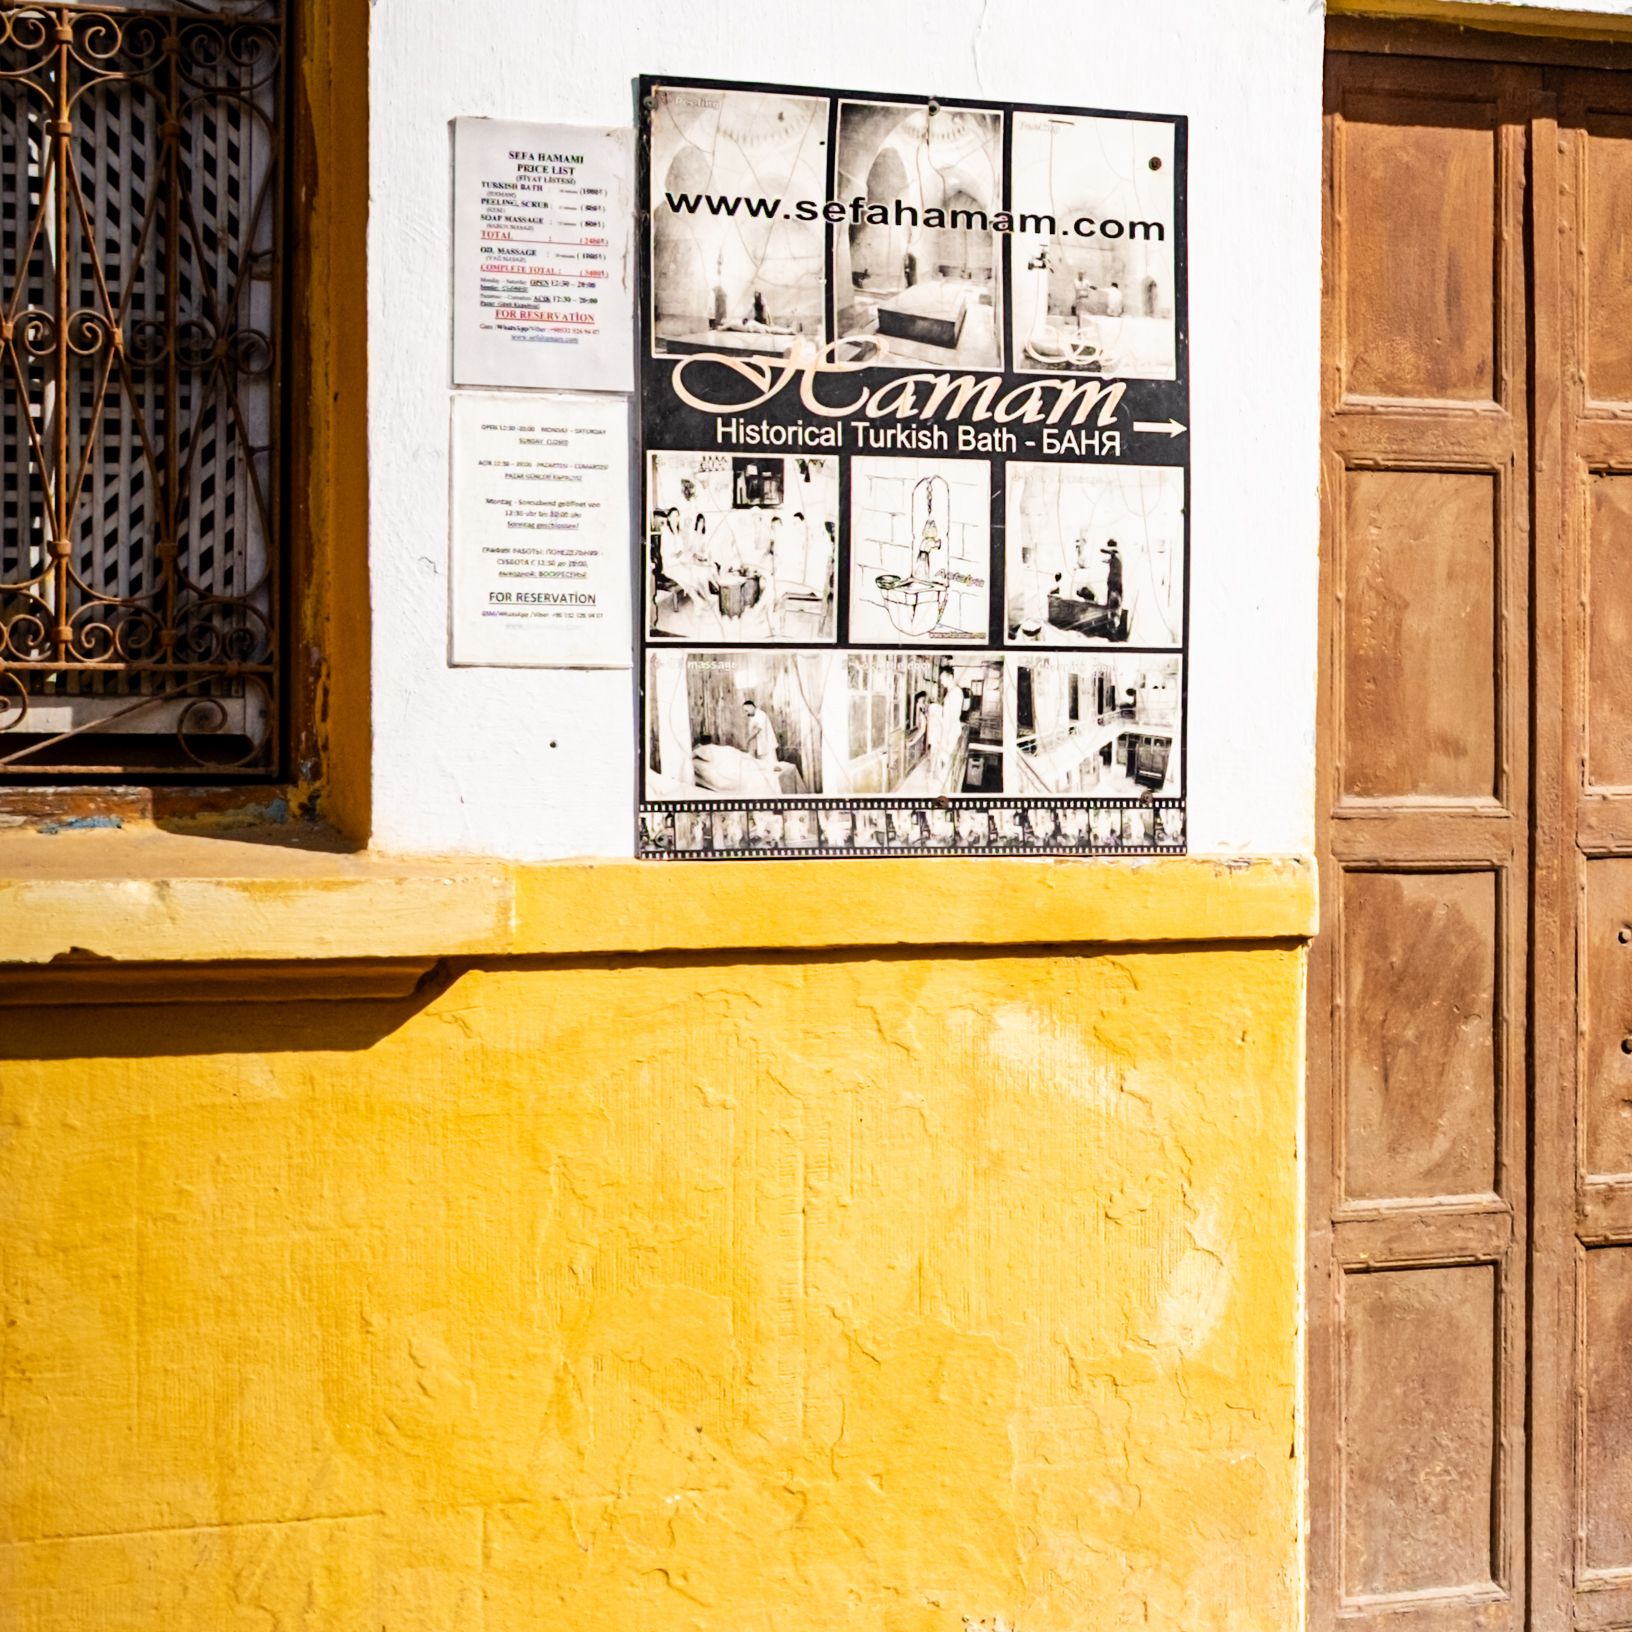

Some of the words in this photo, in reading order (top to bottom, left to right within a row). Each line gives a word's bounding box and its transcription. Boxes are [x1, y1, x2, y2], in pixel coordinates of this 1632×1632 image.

[508, 150, 535, 161] SEFA
[538, 153, 584, 164] HAMAMI
[517, 163, 549, 174] PRICE
[552, 166, 575, 176] LIST
[481, 181, 518, 190] TURKISH
[520, 184, 543, 192] BATH
[480, 214, 502, 222] SOAP
[504, 215, 544, 224] MASSAGE
[665, 192, 1165, 242] www.sefahamam.com
[481, 231, 513, 240] TOTAL
[497, 247, 537, 256] MASSAGE
[495, 309, 517, 319] FOR
[672, 334, 1127, 427] Hamam
[716, 416, 842, 448] Historical
[851, 421, 949, 451] Turkish
[958, 424, 1017, 454] Bath
[1042, 428, 1121, 457] БАНЯ
[489, 591, 512, 602] FOR
